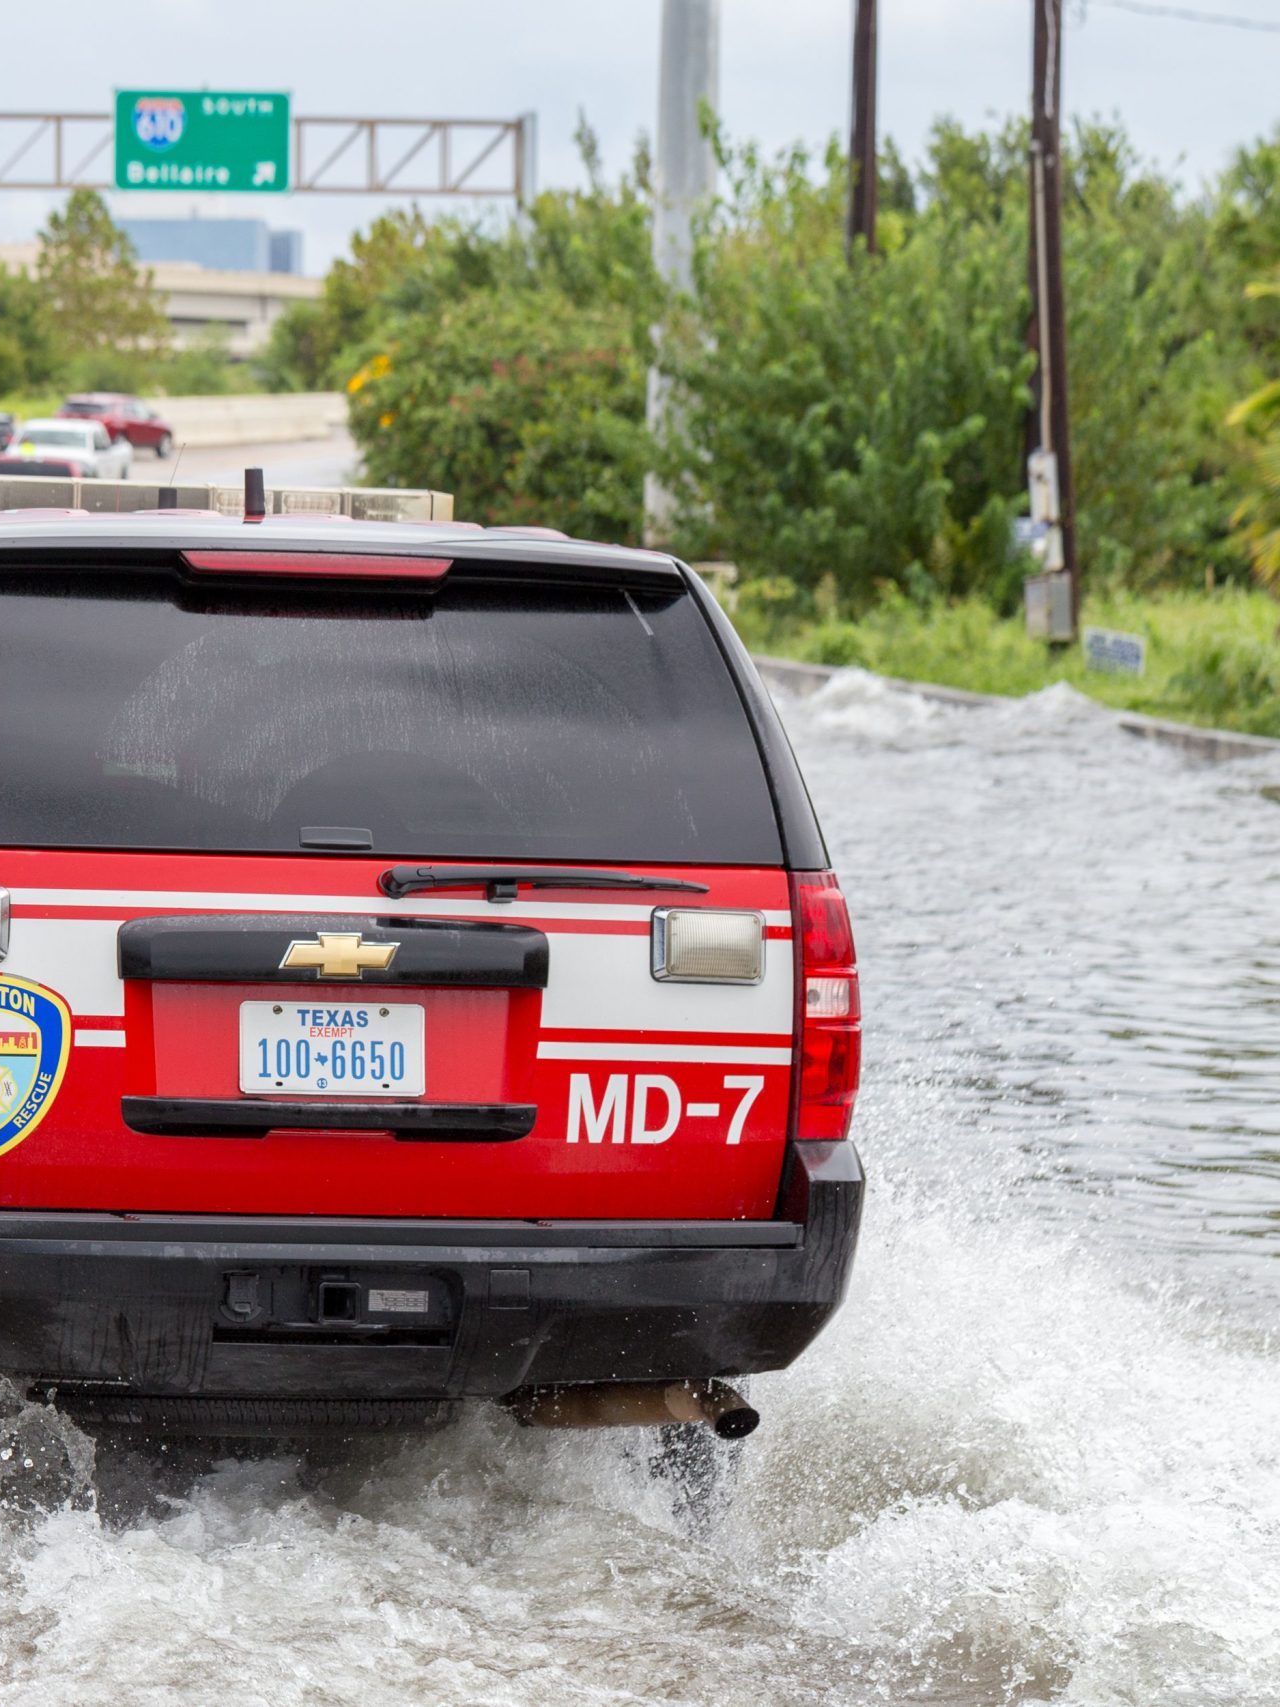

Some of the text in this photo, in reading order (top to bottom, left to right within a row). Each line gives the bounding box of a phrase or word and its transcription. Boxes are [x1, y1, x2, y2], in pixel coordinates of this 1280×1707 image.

[136, 111, 183, 143] 610
[127, 161, 230, 185] Bellaire
[297, 1009, 369, 1027] TEXAS
[309, 1027, 354, 1038] EXEMPT
[258, 1038, 405, 1080] 100 6650
[13, 1072, 52, 1129] RESCUE
[566, 1073, 765, 1145] MD-7
